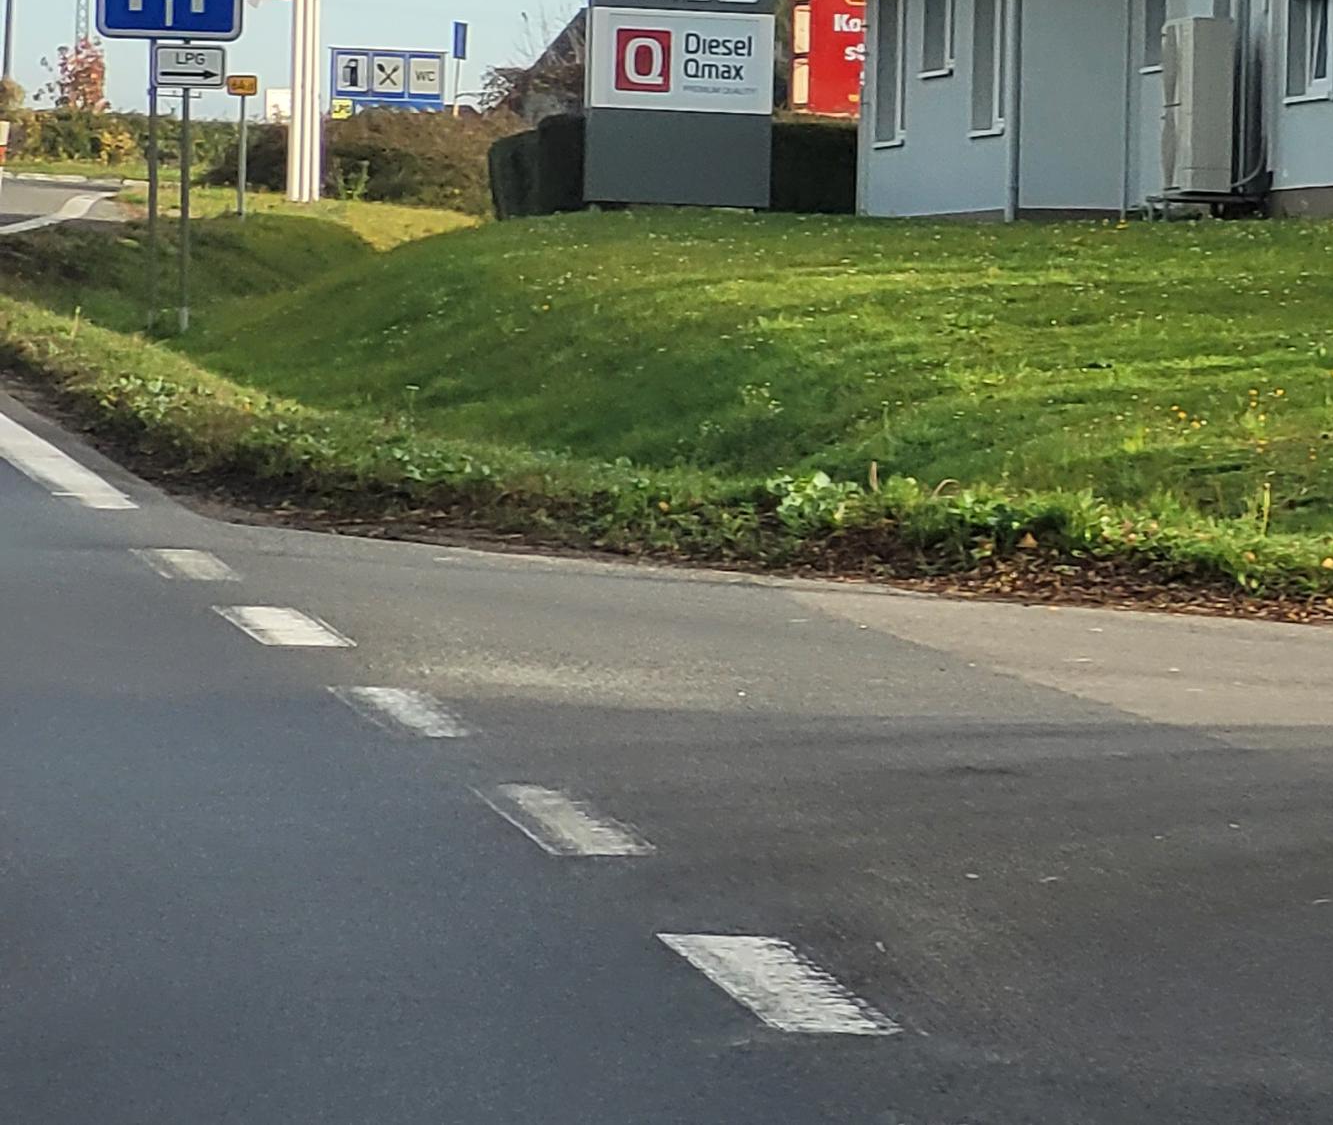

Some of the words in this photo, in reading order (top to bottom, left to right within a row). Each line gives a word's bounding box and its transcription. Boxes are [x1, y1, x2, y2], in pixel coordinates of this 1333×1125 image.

[684, 32, 753, 57] Diesel
[175, 52, 206, 66] LPG
[624, 36, 664, 85] Q
[683, 58, 744, 81] Qmax
[415, 69, 436, 82] WC
